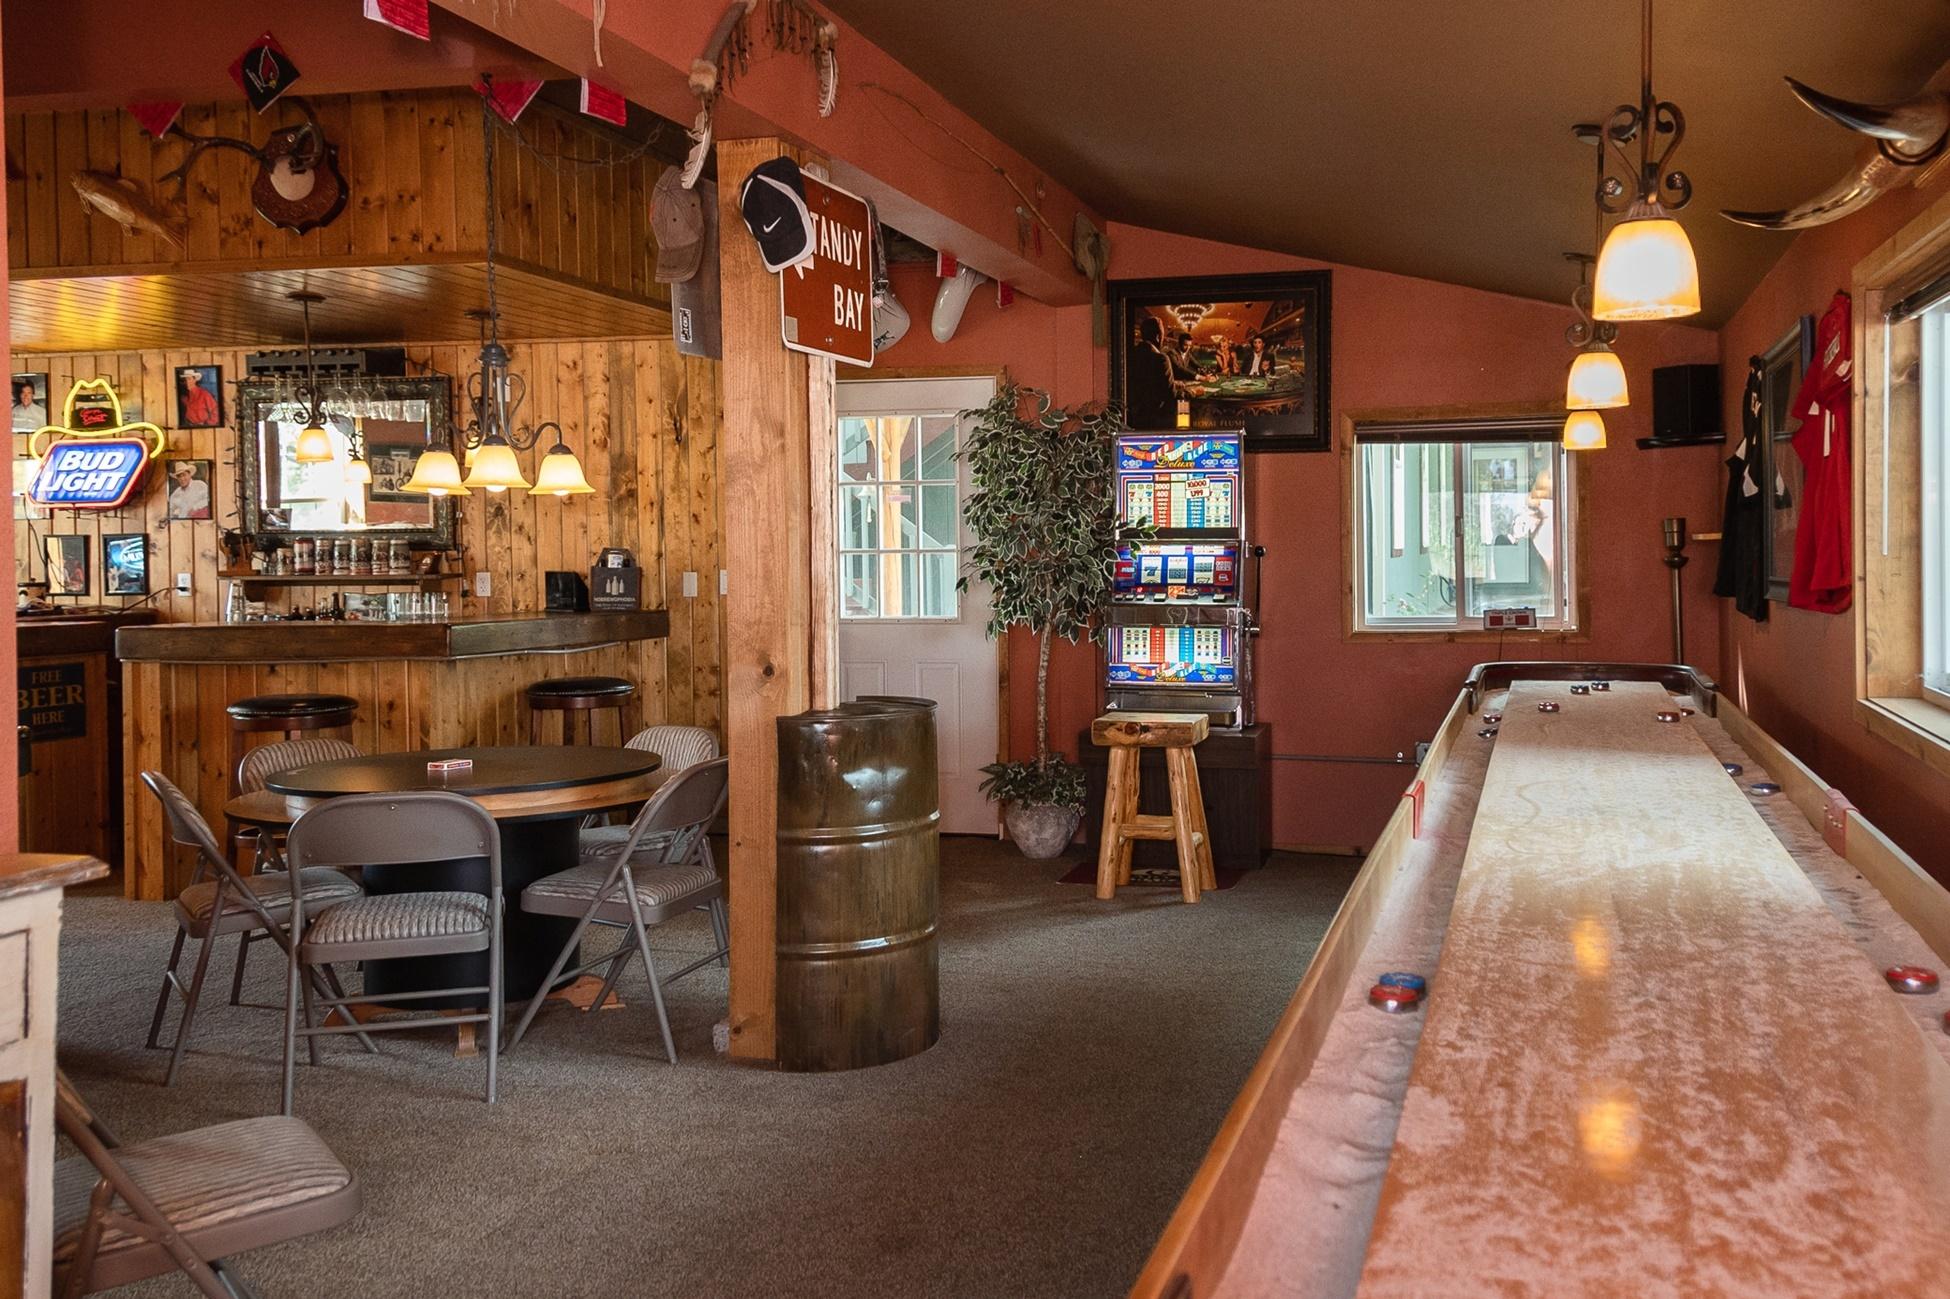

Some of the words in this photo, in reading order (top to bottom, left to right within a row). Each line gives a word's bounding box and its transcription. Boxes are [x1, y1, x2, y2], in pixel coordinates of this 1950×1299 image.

[834, 283, 864, 332] BAY
[57, 450, 125, 472] BUD
[1154, 454, 1195, 468] Deluxe
[39, 471, 128, 492] LIGHT
[18, 684, 84, 711] BEER
[32, 710, 65, 726] HERE
